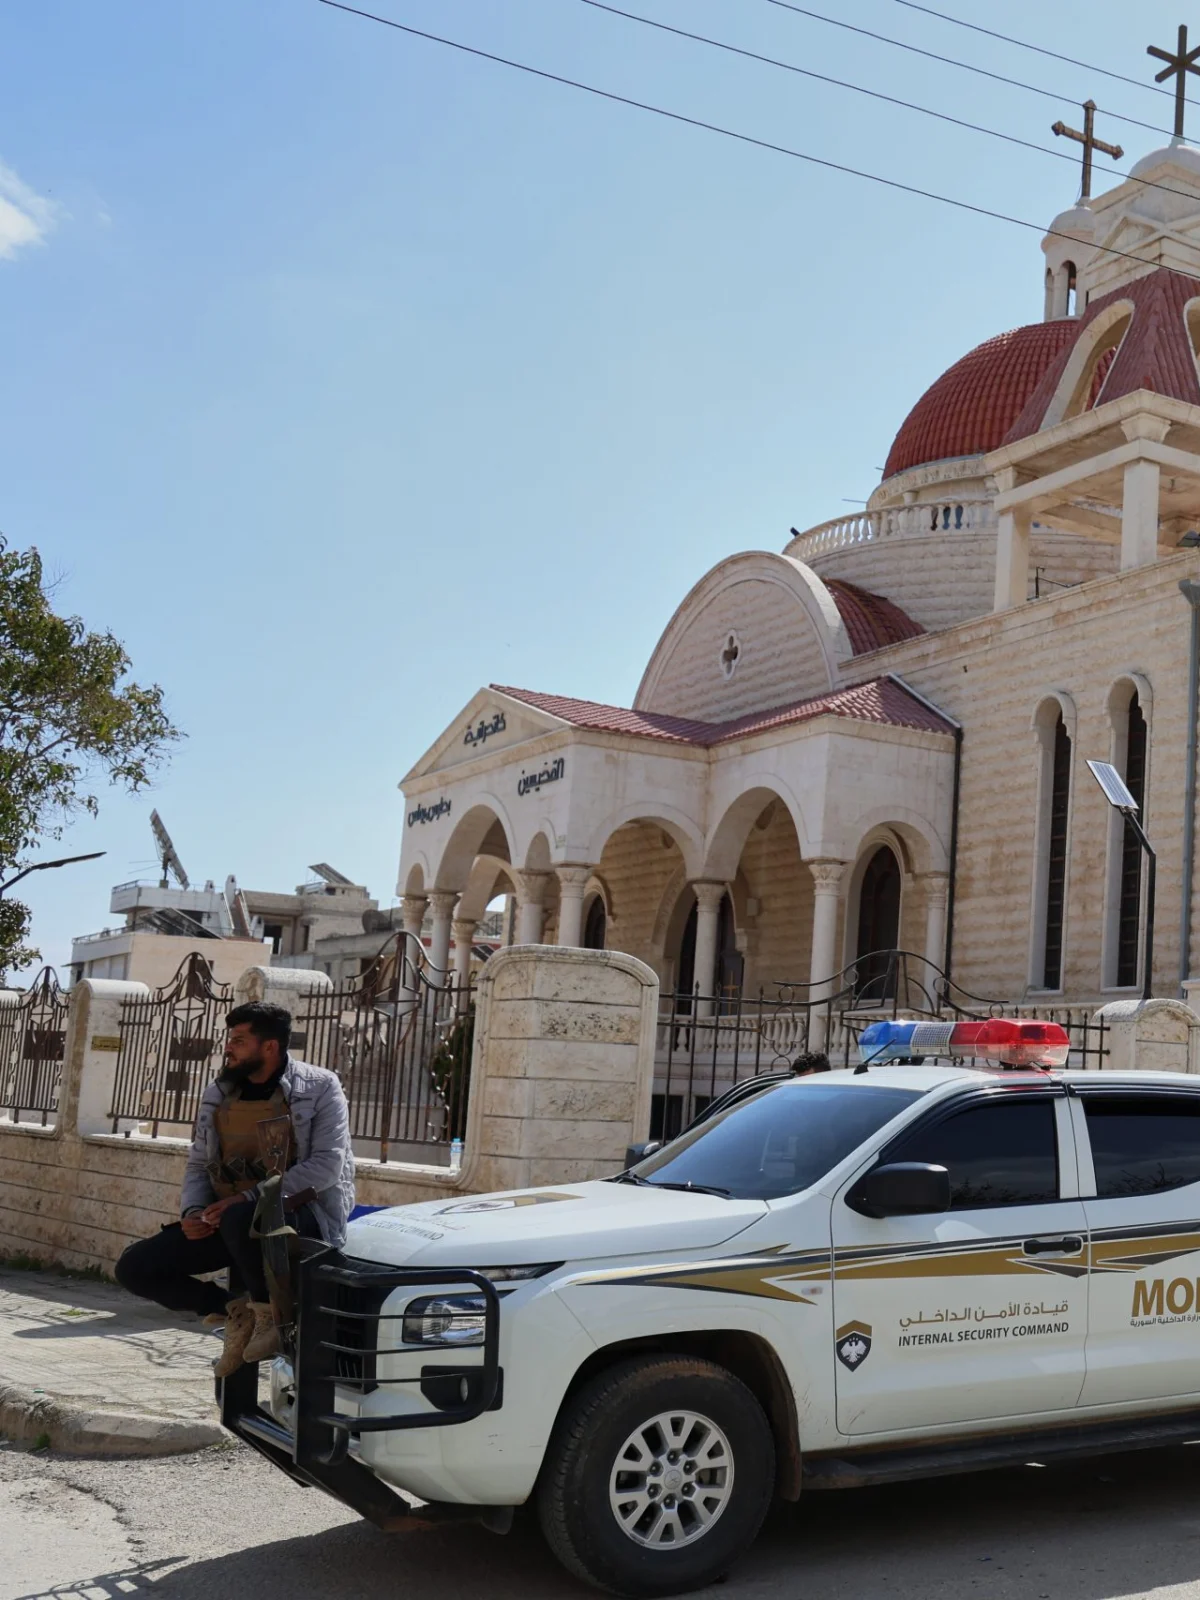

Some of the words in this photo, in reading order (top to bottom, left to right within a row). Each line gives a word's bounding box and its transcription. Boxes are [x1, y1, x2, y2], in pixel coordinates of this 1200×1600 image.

[974, 1302, 1021, 1322] الأمن
[1023, 1299, 1069, 1316] قيادة
[899, 1307, 972, 1332] الداخلي
[1130, 1318, 1157, 1327] السورية
[1157, 1315, 1186, 1324] الداخلية
[898, 1331, 955, 1347] INTERNAL
[957, 1326, 1010, 1342] SECURITY
[1012, 1322, 1069, 1337] COMMAND
